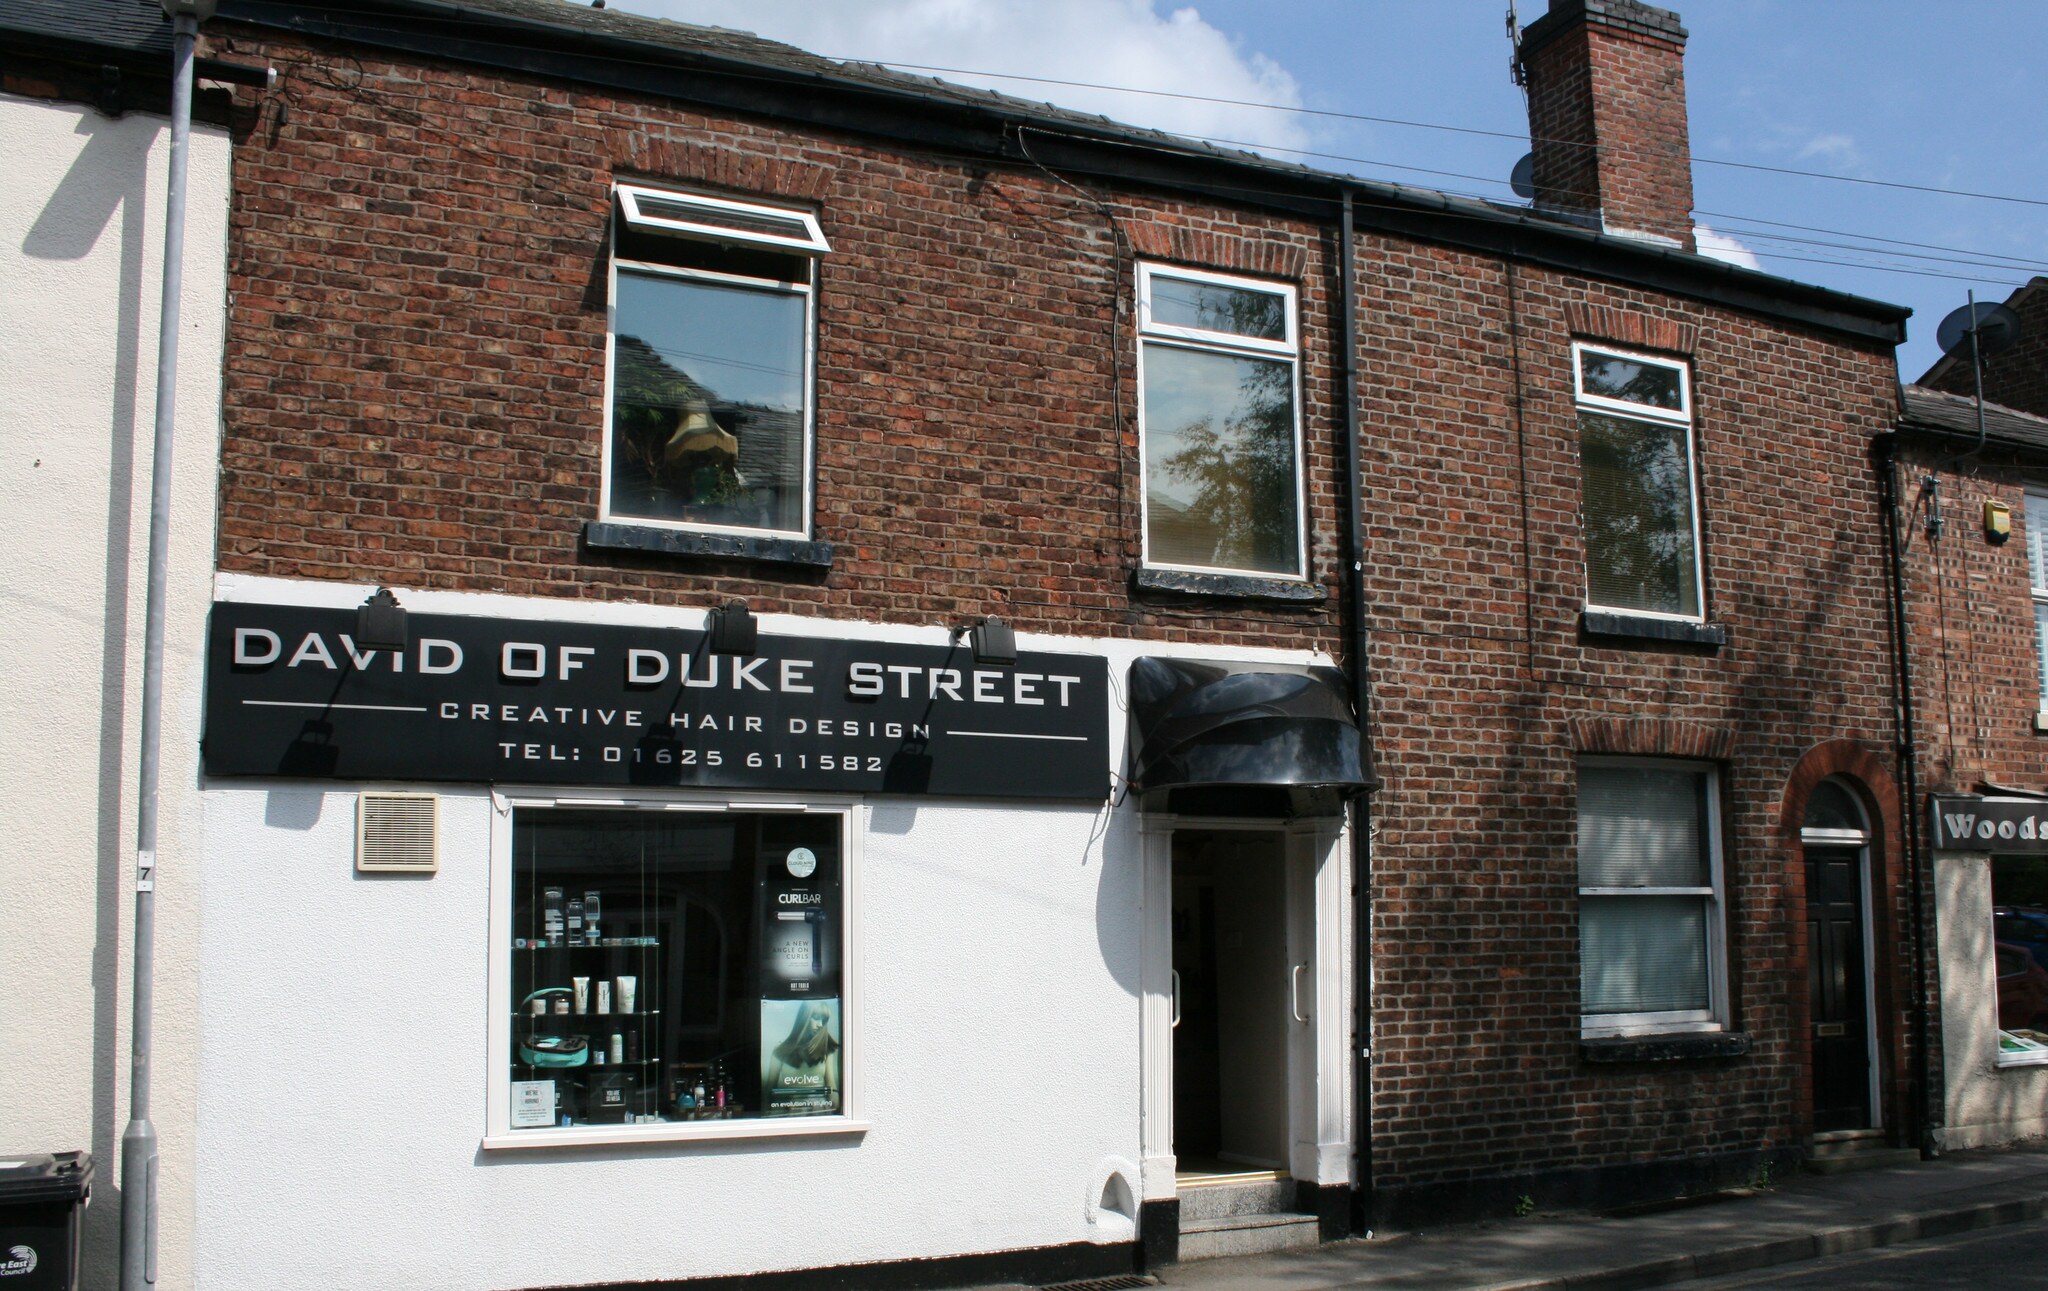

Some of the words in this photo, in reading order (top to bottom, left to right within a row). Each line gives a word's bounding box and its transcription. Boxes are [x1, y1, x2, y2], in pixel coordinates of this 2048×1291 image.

[233, 627, 464, 675] DAVID
[501, 641, 596, 681] OF
[628, 648, 814, 694] DUKE
[848, 662, 1081, 707] STREET
[438, 702, 643, 727] CREATIVE
[670, 712, 763, 733] HAIR
[789, 718, 930, 740] DESIGN
[498, 742, 580, 762] TEL:
[603, 746, 723, 767] 01625
[746, 752, 883, 773] 611582
[141, 867, 151, 880] 7
[778, 893, 822, 904] CURLBAR
[784, 1074, 820, 1084] evolve
[8, 1260, 28, 1268] East
